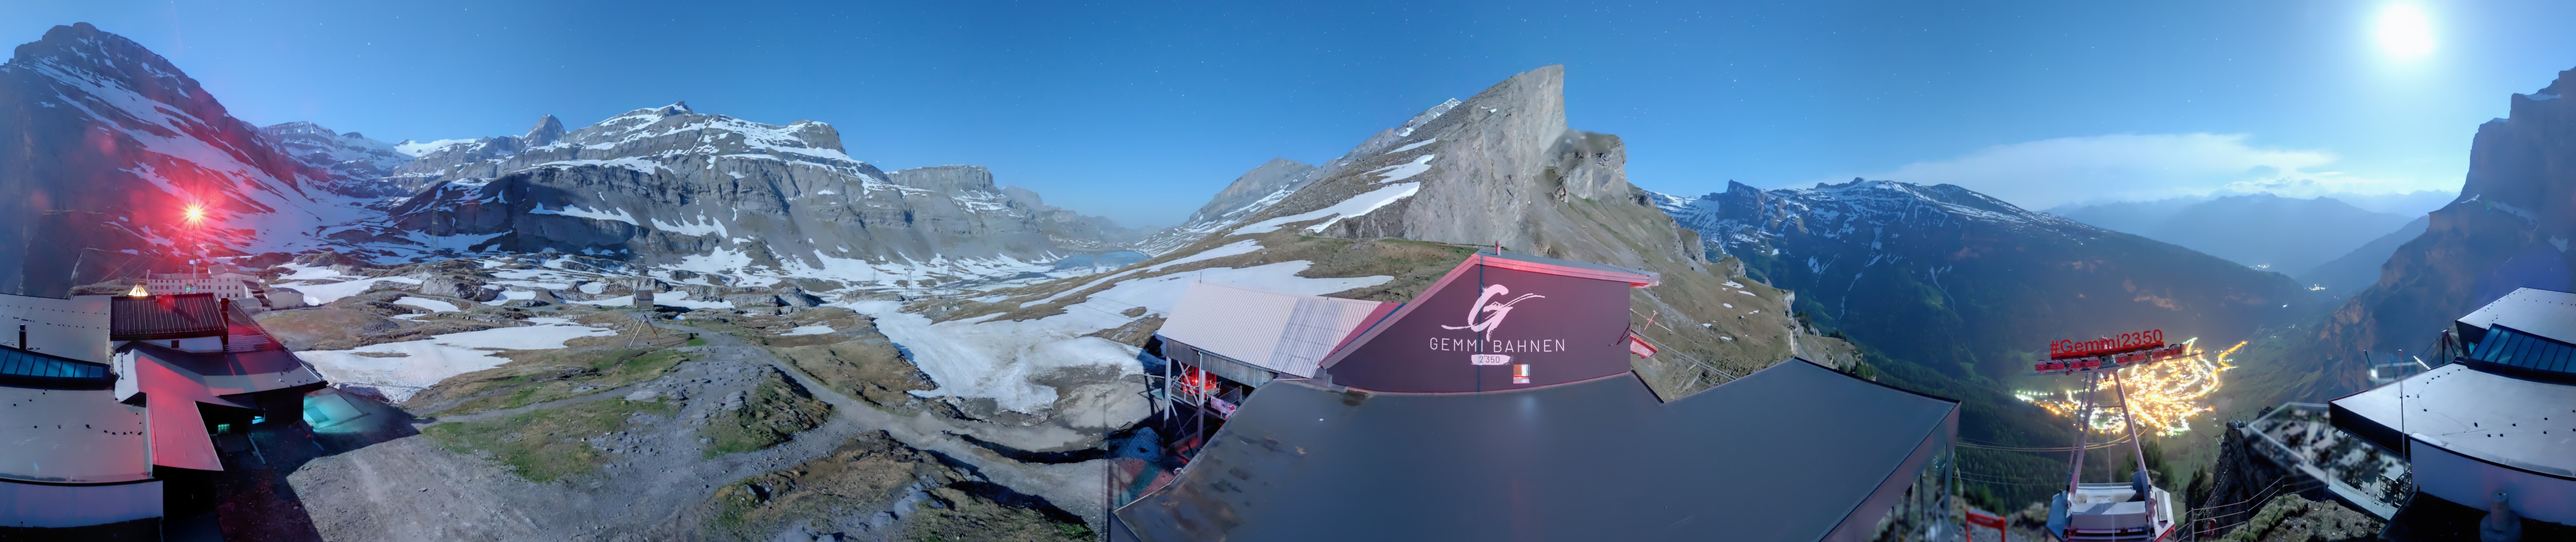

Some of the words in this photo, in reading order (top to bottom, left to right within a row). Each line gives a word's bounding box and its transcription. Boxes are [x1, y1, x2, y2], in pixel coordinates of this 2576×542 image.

[1430, 337, 1483, 351] GEMMI
[1494, 339, 1565, 353] BAHNEN
[2050, 329, 2162, 354] #Gemmi2350
